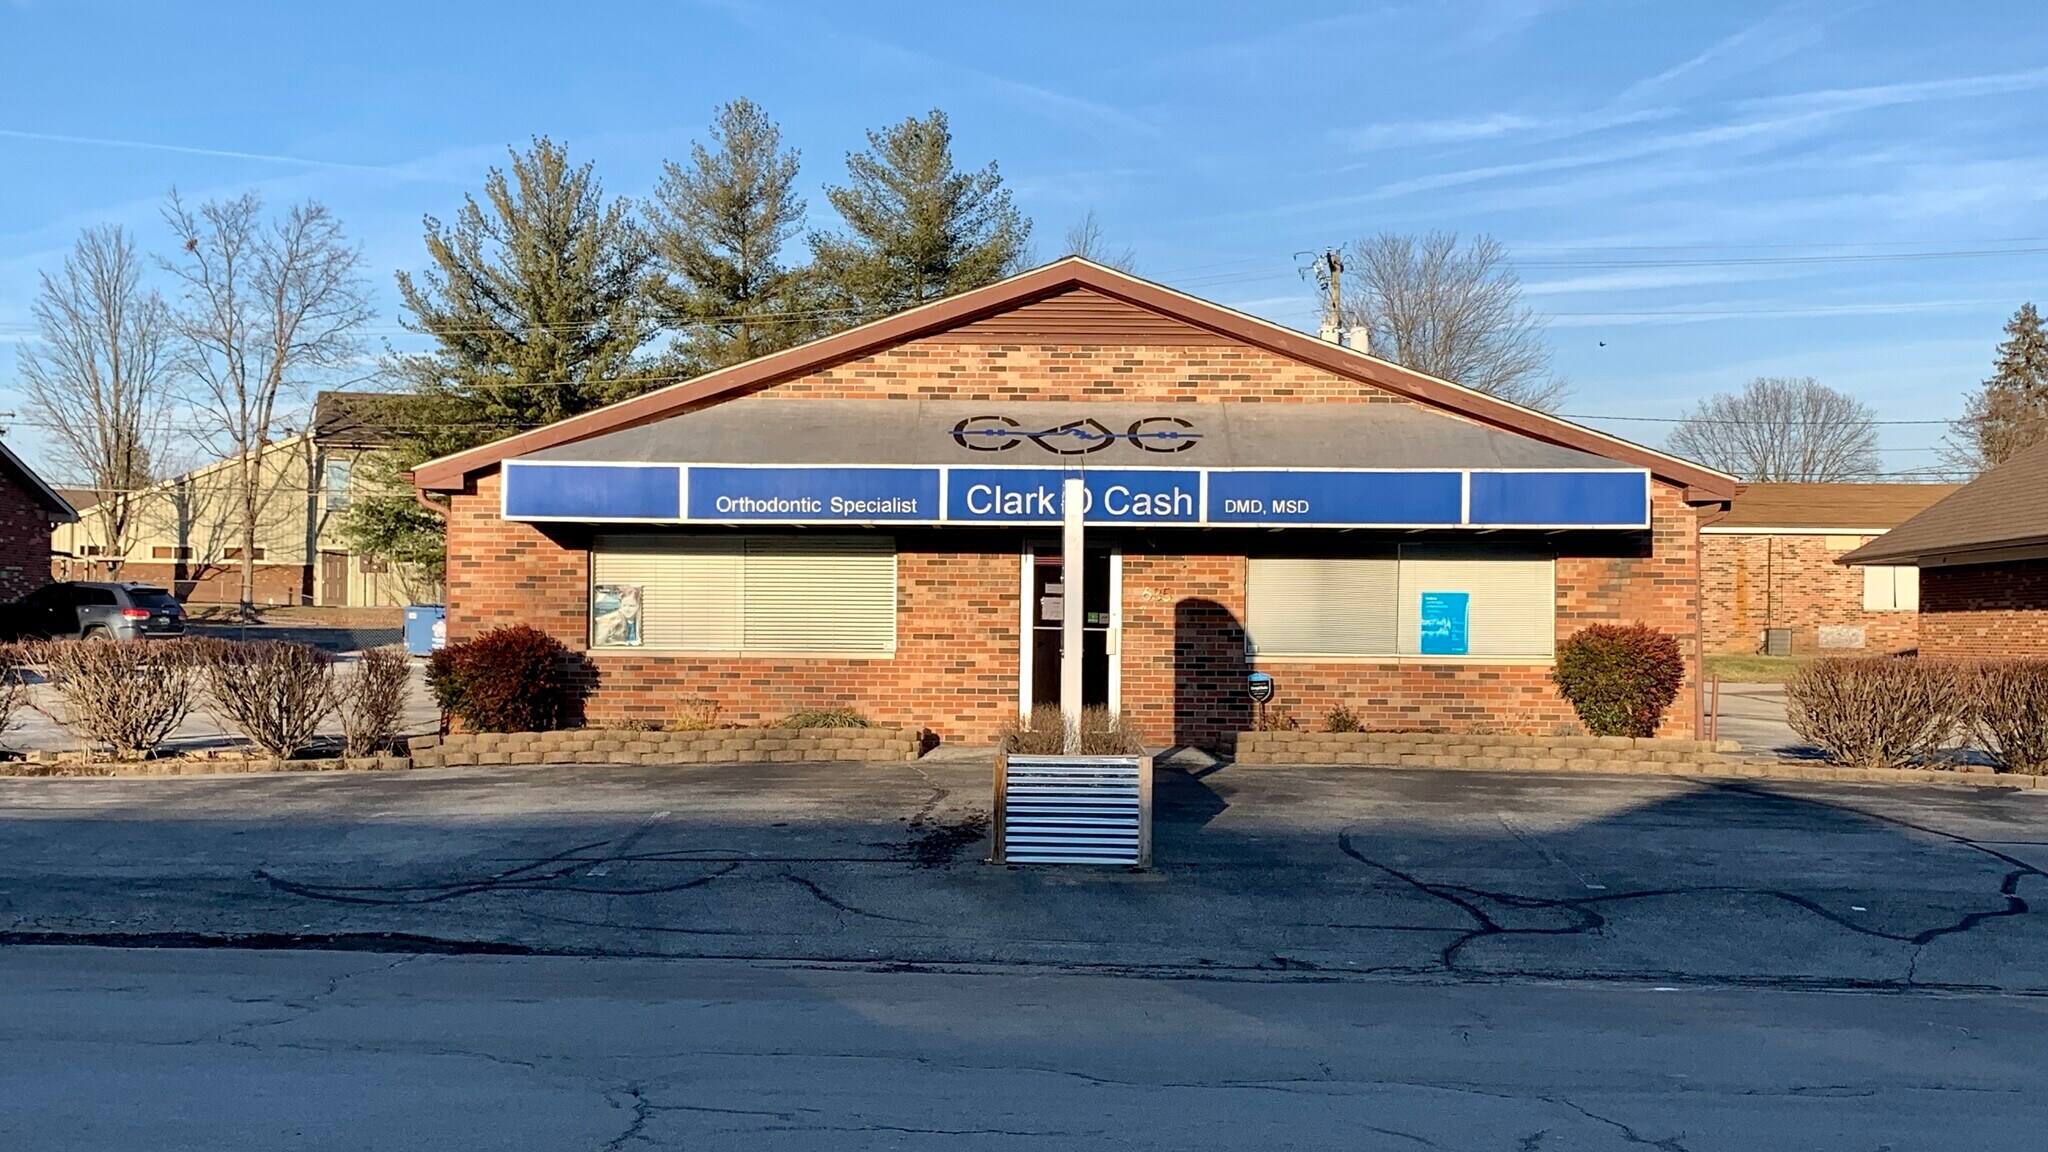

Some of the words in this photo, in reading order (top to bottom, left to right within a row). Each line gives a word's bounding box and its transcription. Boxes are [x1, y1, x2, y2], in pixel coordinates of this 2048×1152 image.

[716, 496, 821, 513] Orthodontic
[830, 496, 918, 516] Specialist
[966, 484, 1056, 515] Clark
[1104, 485, 1193, 516] Cash
[1225, 499, 1267, 515] DMD,
[1272, 500, 1309, 514] MSD
